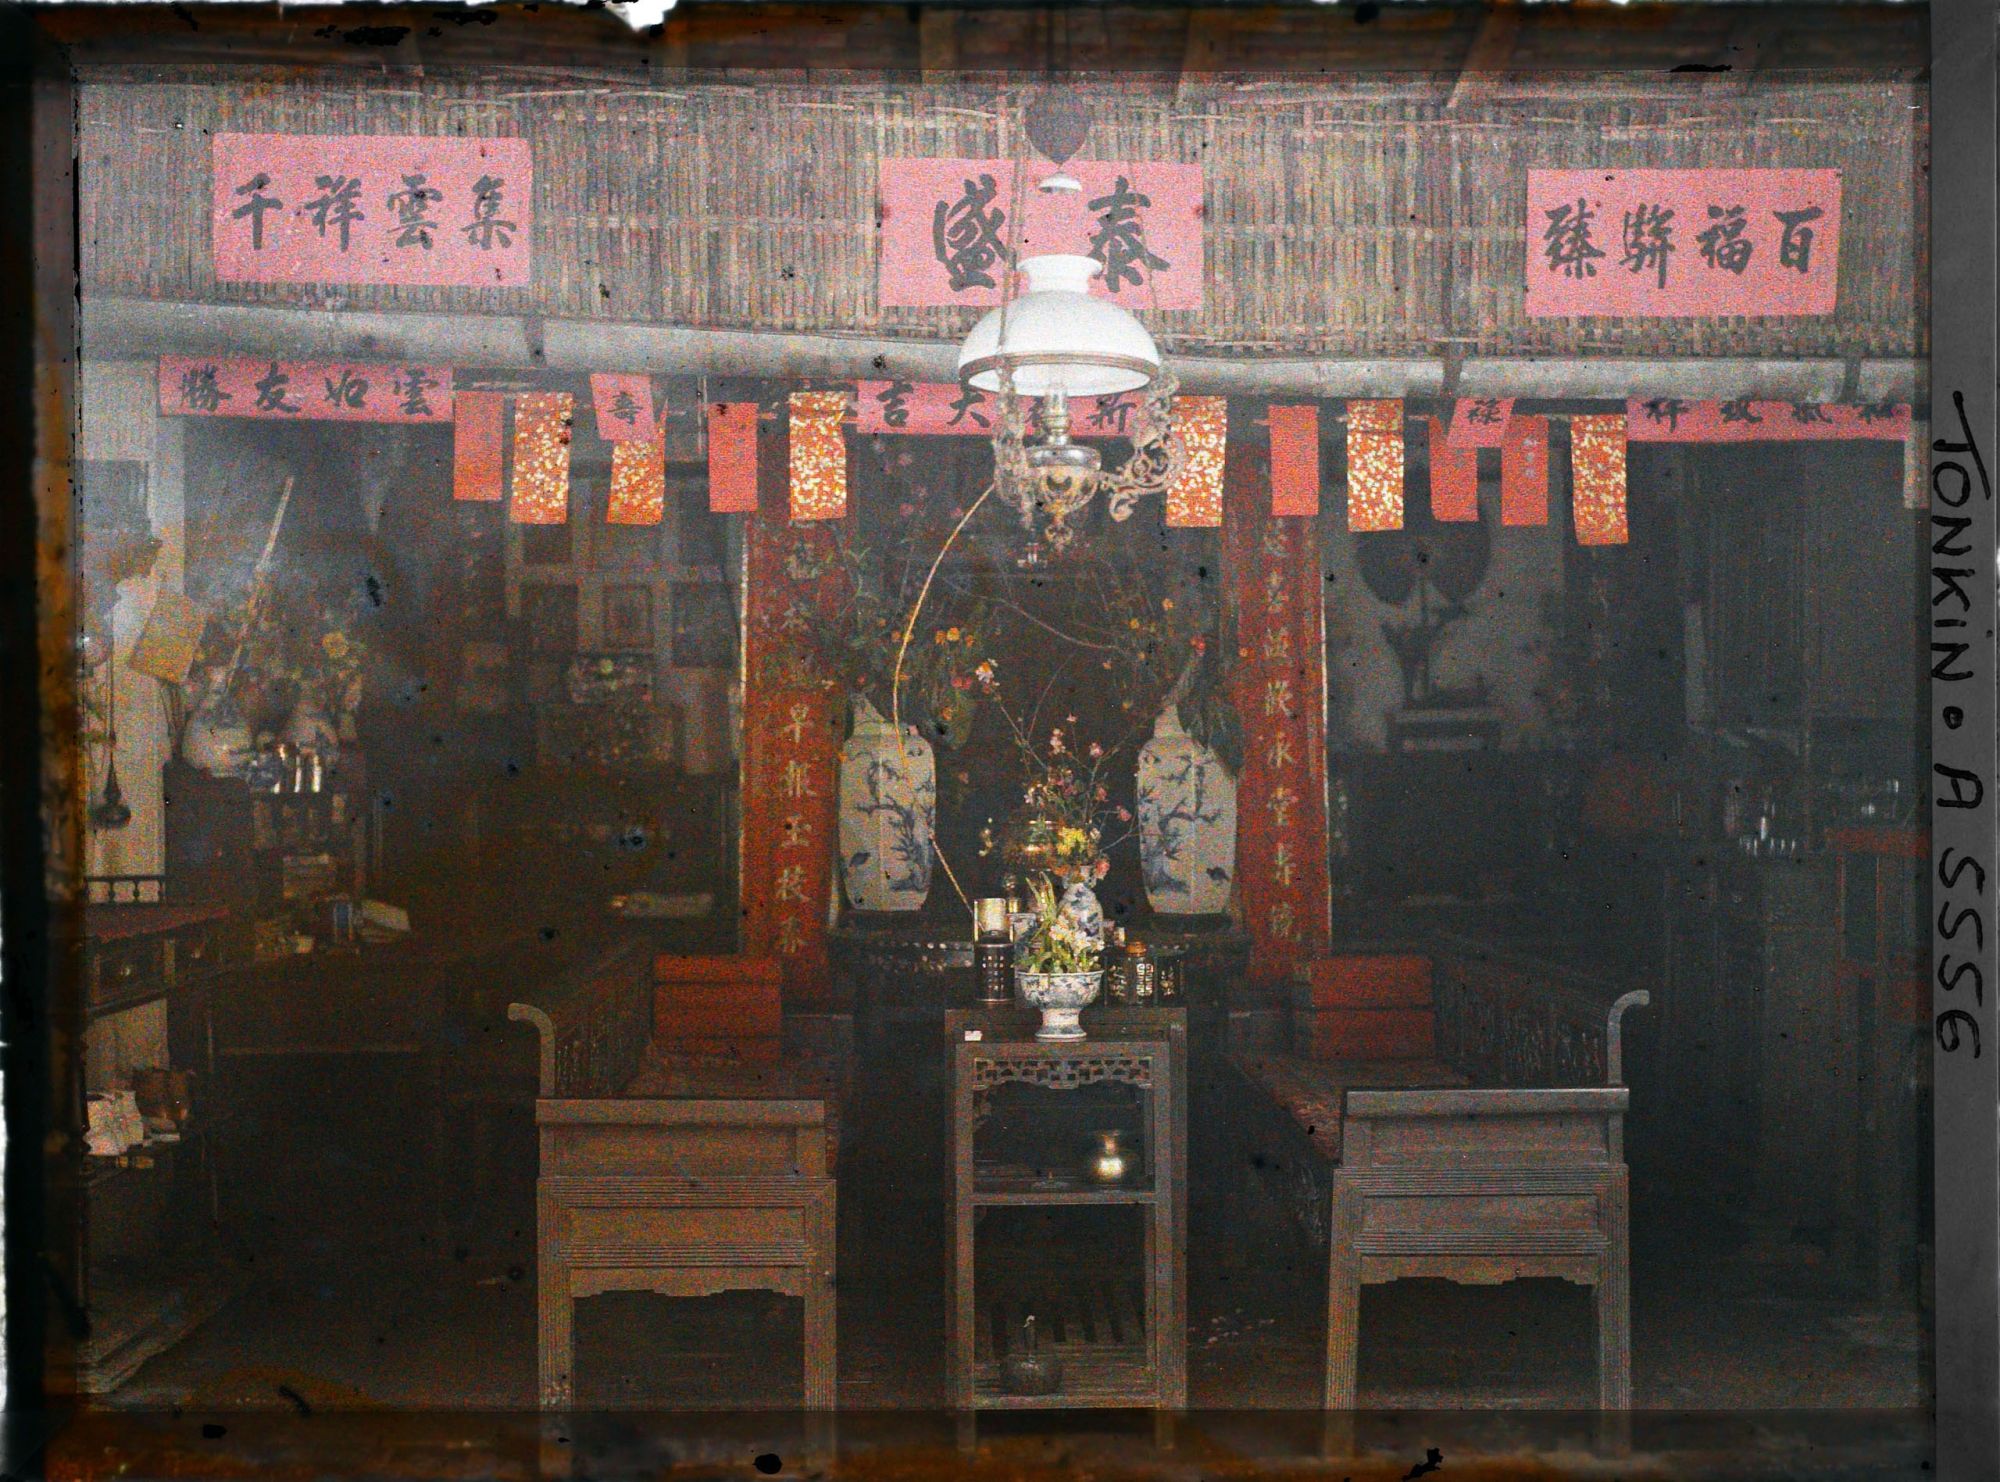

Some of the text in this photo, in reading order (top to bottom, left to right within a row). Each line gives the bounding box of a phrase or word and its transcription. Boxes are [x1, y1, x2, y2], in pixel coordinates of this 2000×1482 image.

[232, 173, 516, 251] 千祥雲集
[1544, 198, 1824, 289] 百福駢臻
[1932, 391, 1991, 680] TONKIN
[1934, 763, 1984, 810] A
